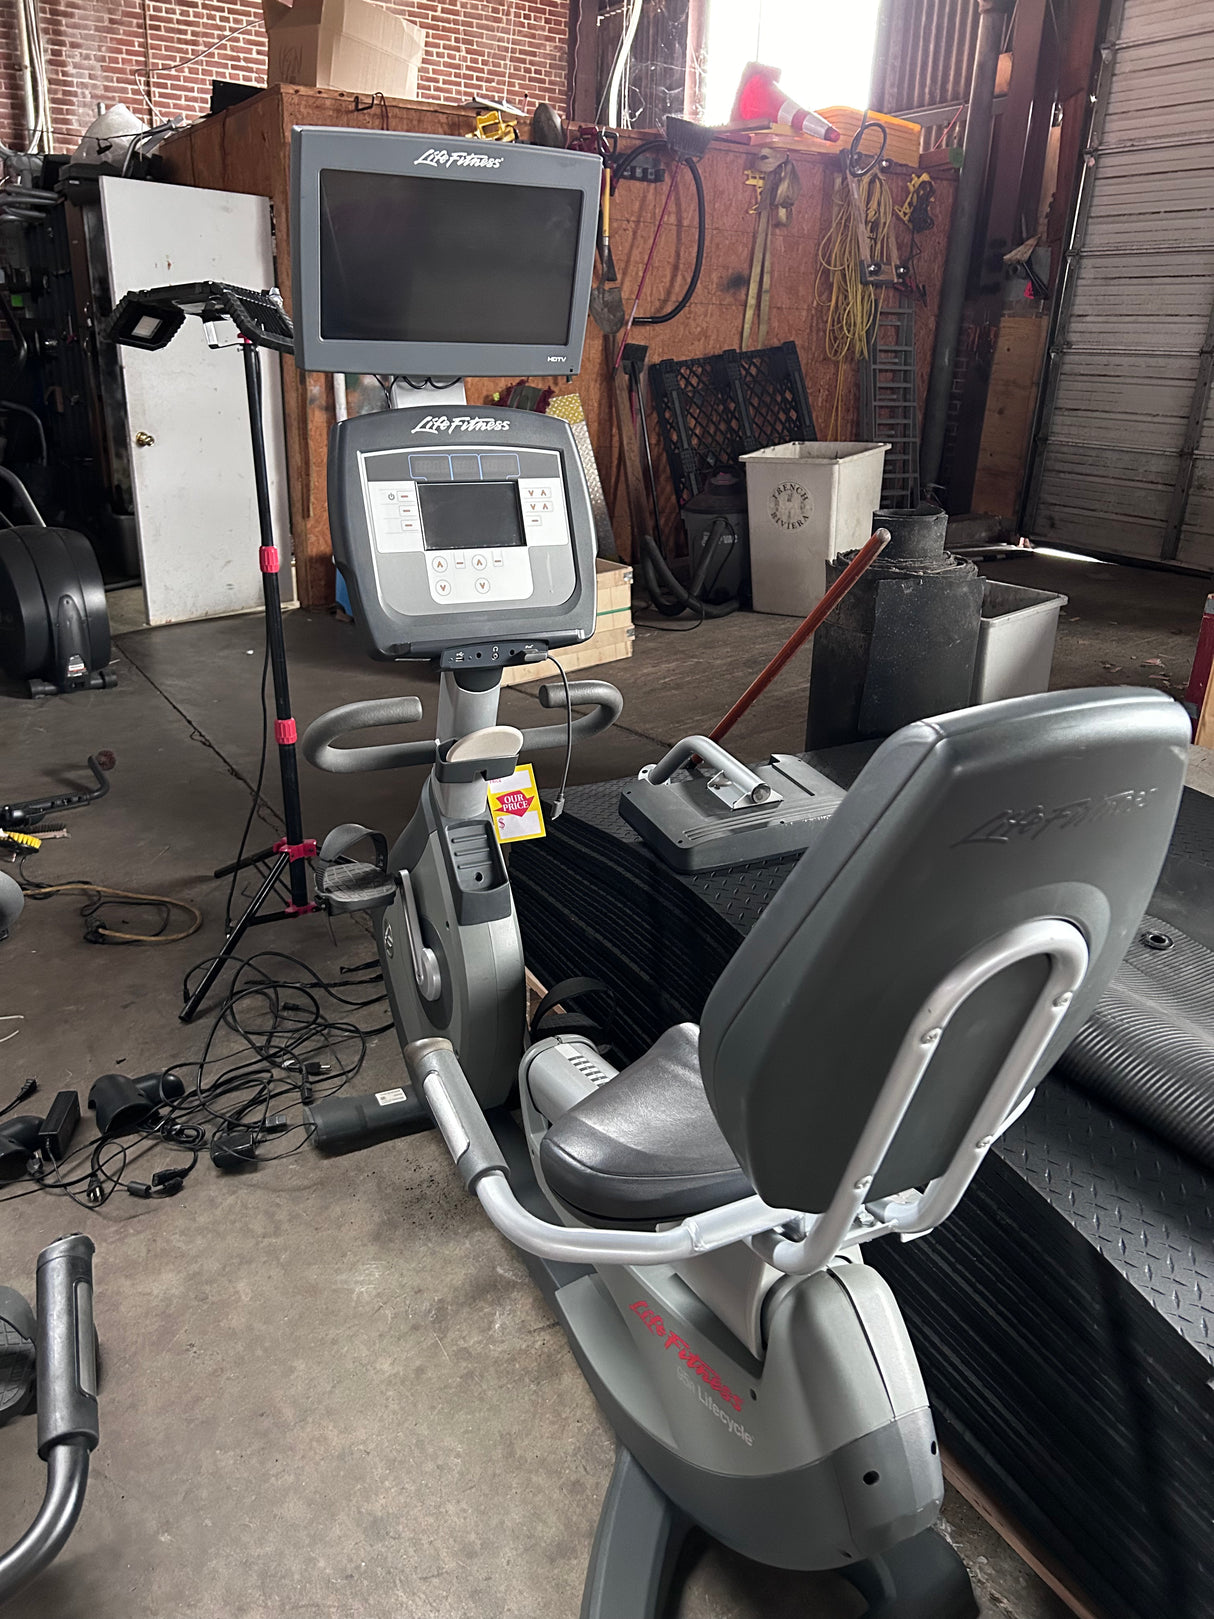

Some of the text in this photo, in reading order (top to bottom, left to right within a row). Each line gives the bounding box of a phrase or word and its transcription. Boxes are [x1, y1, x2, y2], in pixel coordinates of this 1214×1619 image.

[772, 483, 809, 501] FRENCH
[770, 511, 809, 530] RIVIERA
[504, 793, 525, 804] OUR
[502, 801, 529, 812] PRICE
[498, 817, 506, 830] $
[696, 1384, 754, 1447] Lifecycle
